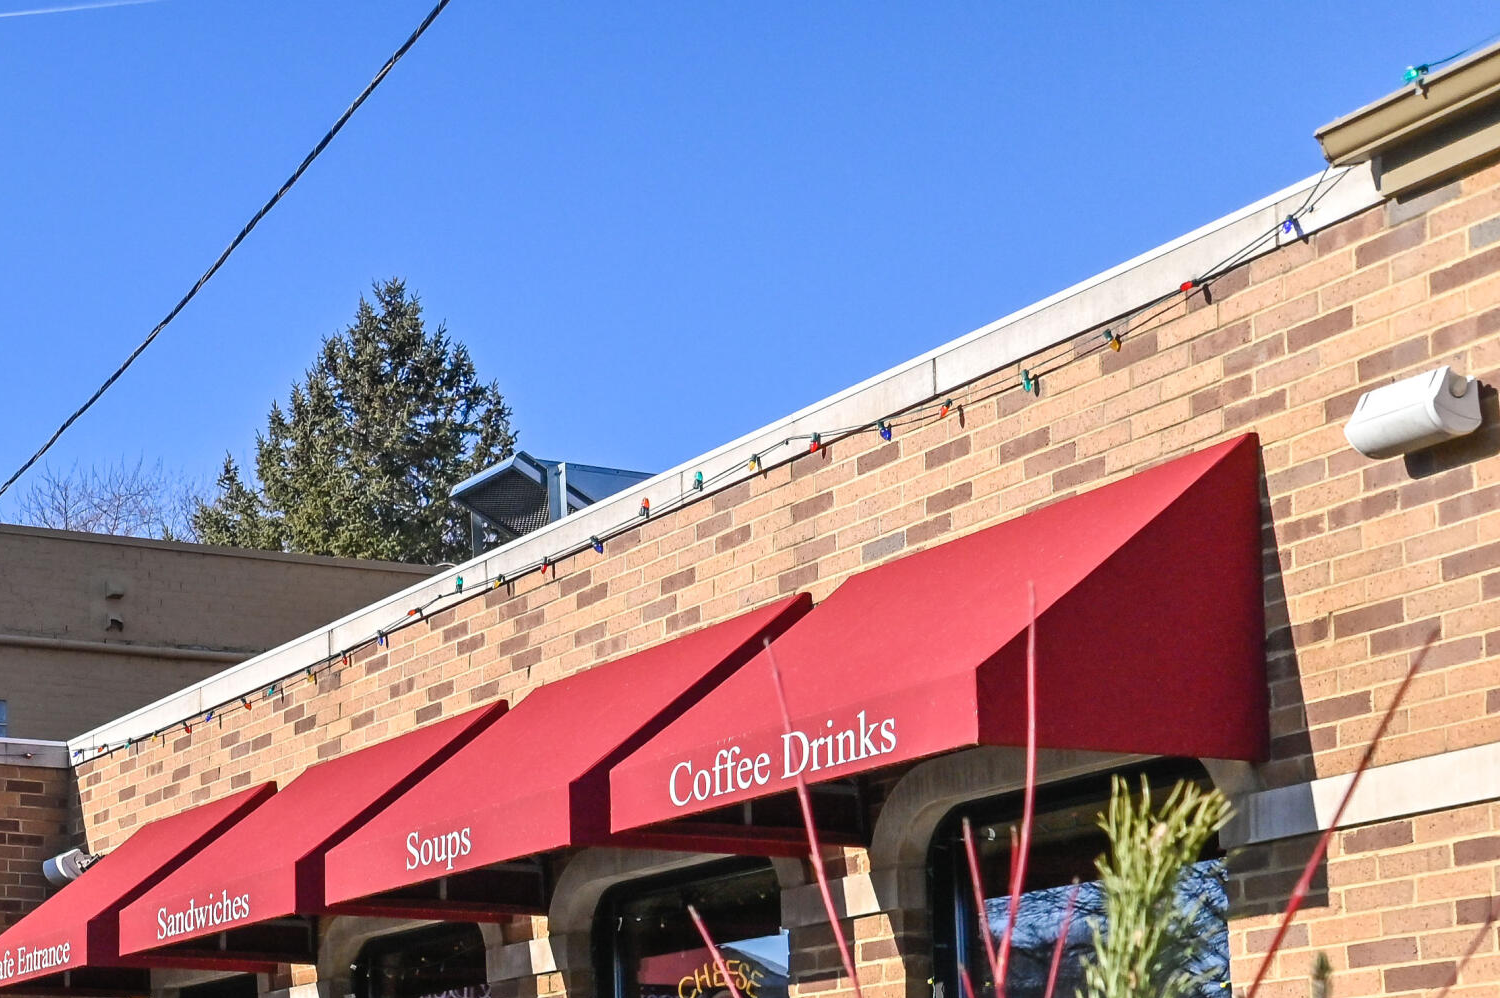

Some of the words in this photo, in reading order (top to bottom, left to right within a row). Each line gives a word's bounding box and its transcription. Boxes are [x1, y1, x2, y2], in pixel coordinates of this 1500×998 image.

[669, 746, 771, 808] Coffee
[780, 709, 898, 781] Drinks
[405, 826, 472, 873] Soups
[156, 889, 250, 941] Sandwiches
[17, 940, 71, 976] Entrance
